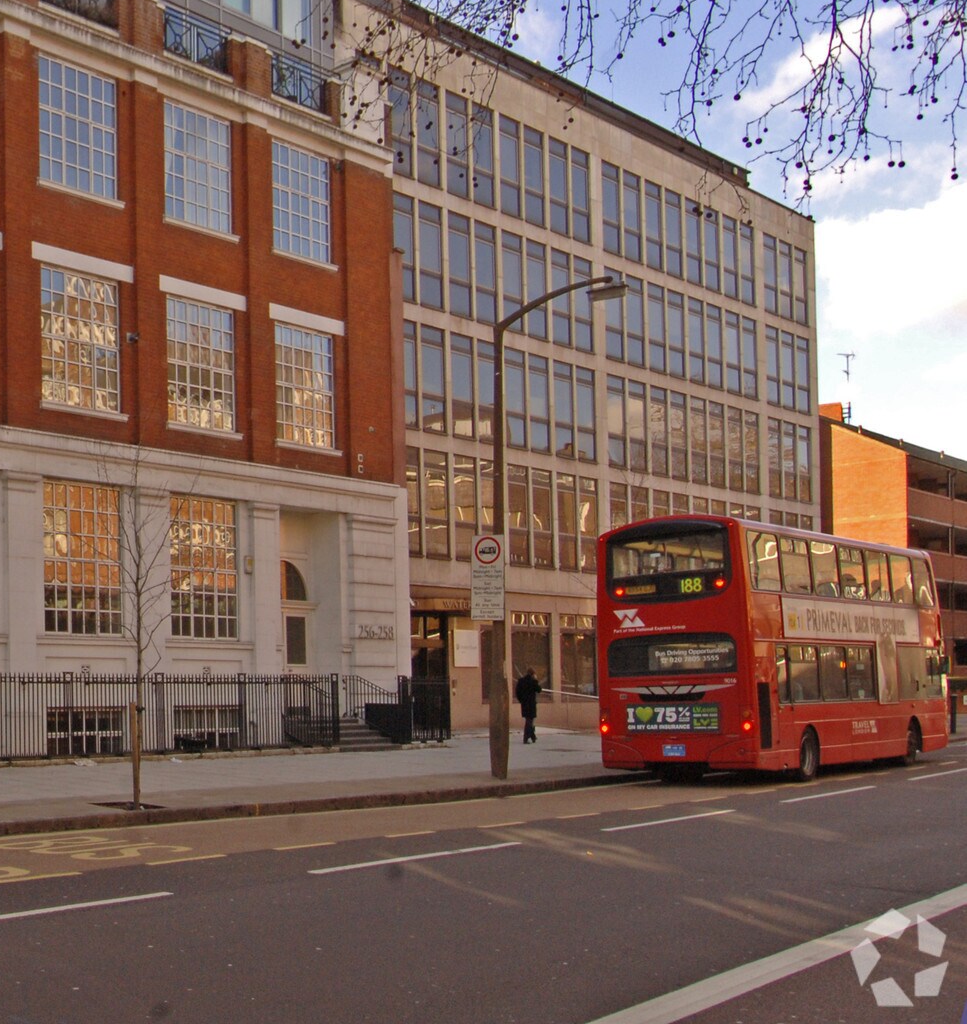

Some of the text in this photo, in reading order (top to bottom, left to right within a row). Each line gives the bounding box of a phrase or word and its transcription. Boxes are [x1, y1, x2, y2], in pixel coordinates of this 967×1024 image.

[680, 577, 702, 593] 188
[806, 608, 853, 633] PRIMEVAL
[357, 624, 394, 640] 256-258
[688, 647, 729, 655] Opportunities
[626, 707, 635, 724] I
[852, 720, 870, 728] TRAVEL
